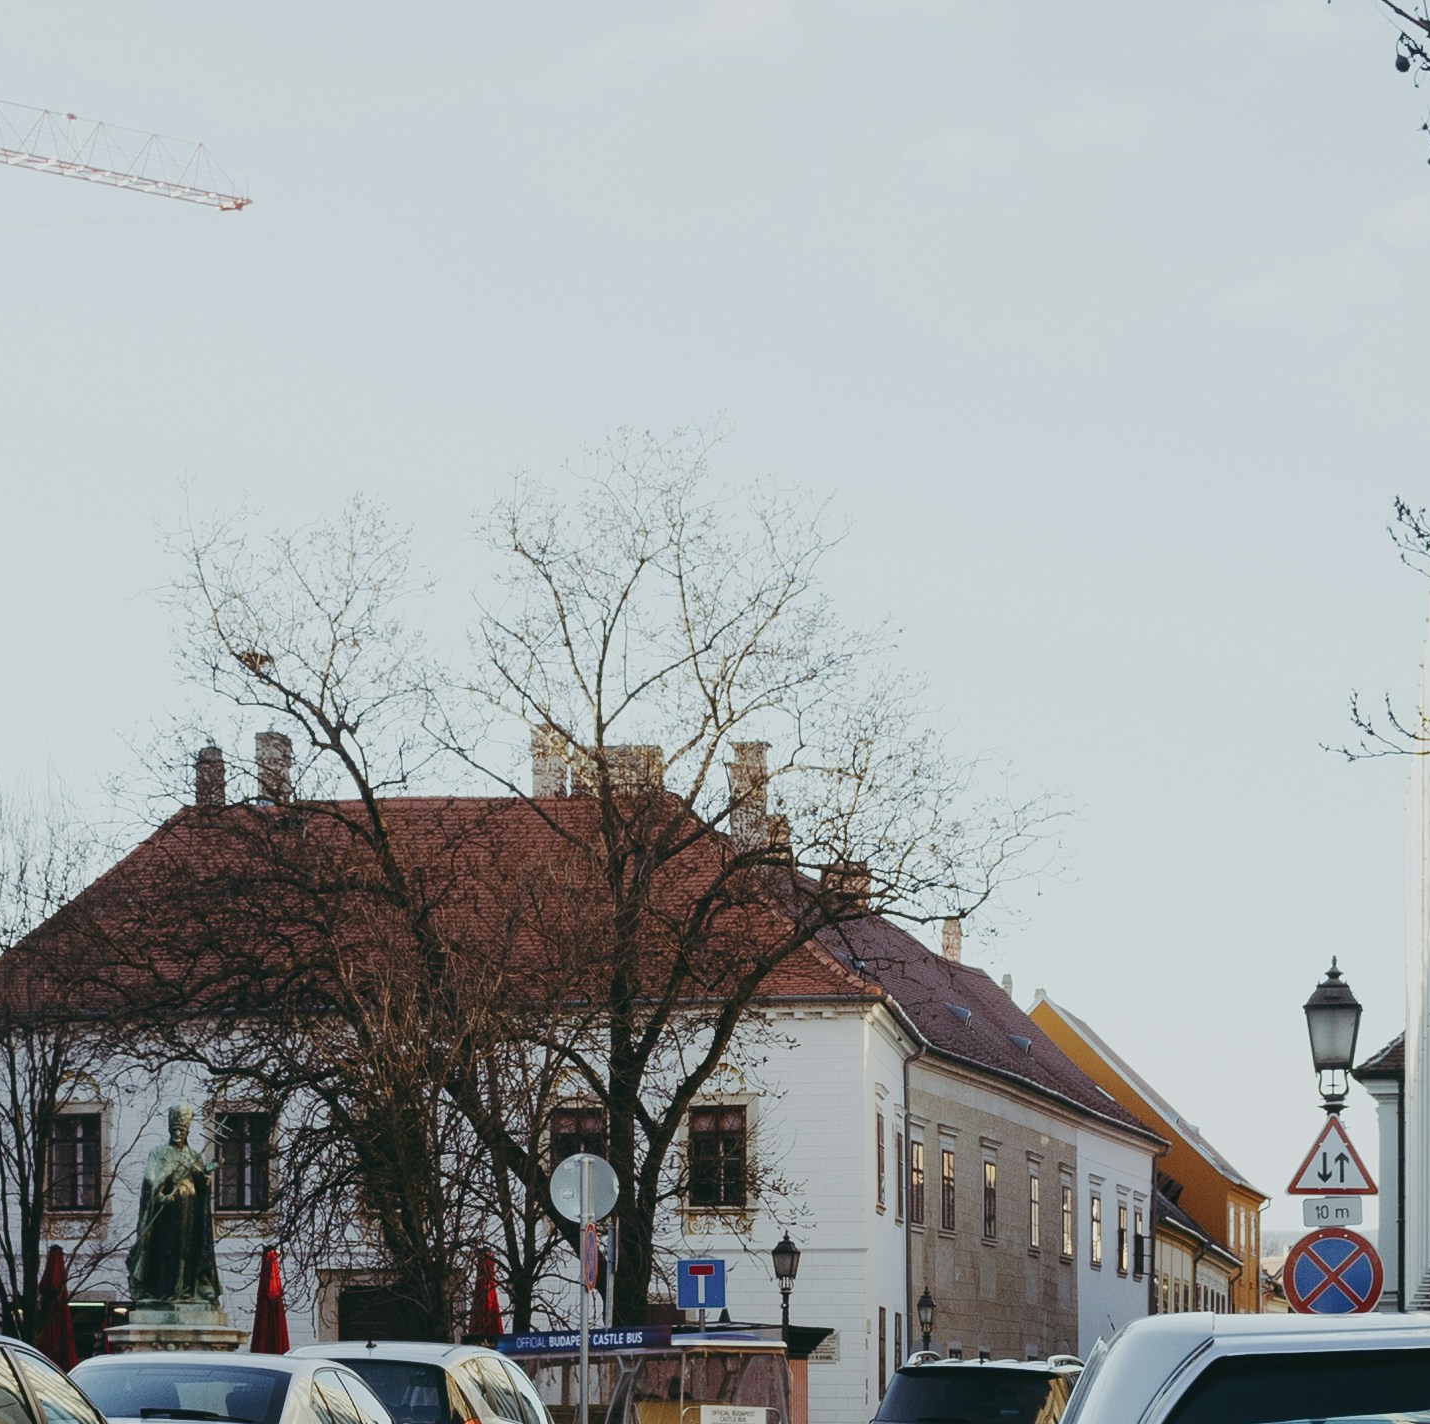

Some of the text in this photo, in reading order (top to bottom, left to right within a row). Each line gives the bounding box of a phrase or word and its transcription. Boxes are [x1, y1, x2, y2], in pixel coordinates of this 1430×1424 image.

[1315, 1205, 1350, 1219] 10 m
[516, 1331, 643, 1349] OFFICIAL BUDAPE CASTLE BUS
